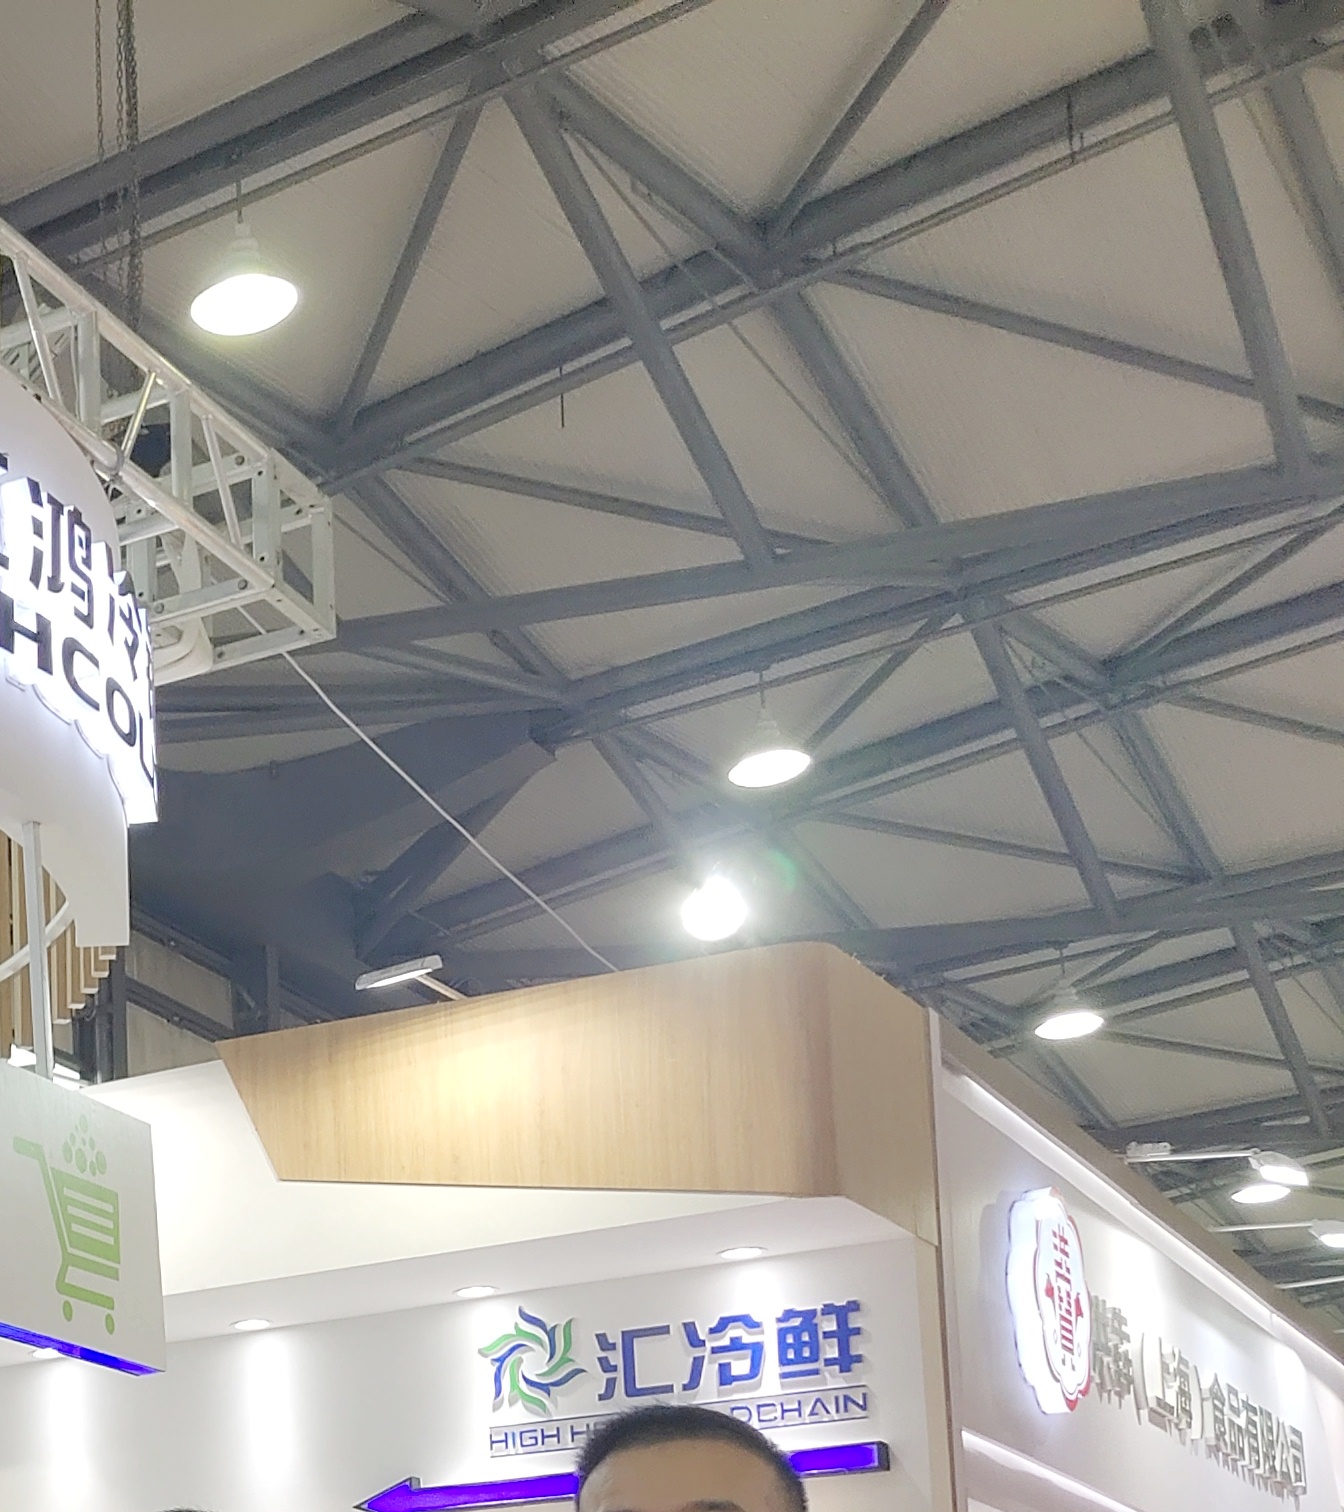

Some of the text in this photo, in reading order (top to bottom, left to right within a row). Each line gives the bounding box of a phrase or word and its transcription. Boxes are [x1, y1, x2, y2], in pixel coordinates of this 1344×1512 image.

[594, 1300, 863, 1401] 汇冷鲜
[489, 1422, 561, 1451] HIGH
[729, 1392, 869, 1424] DCHAIN
